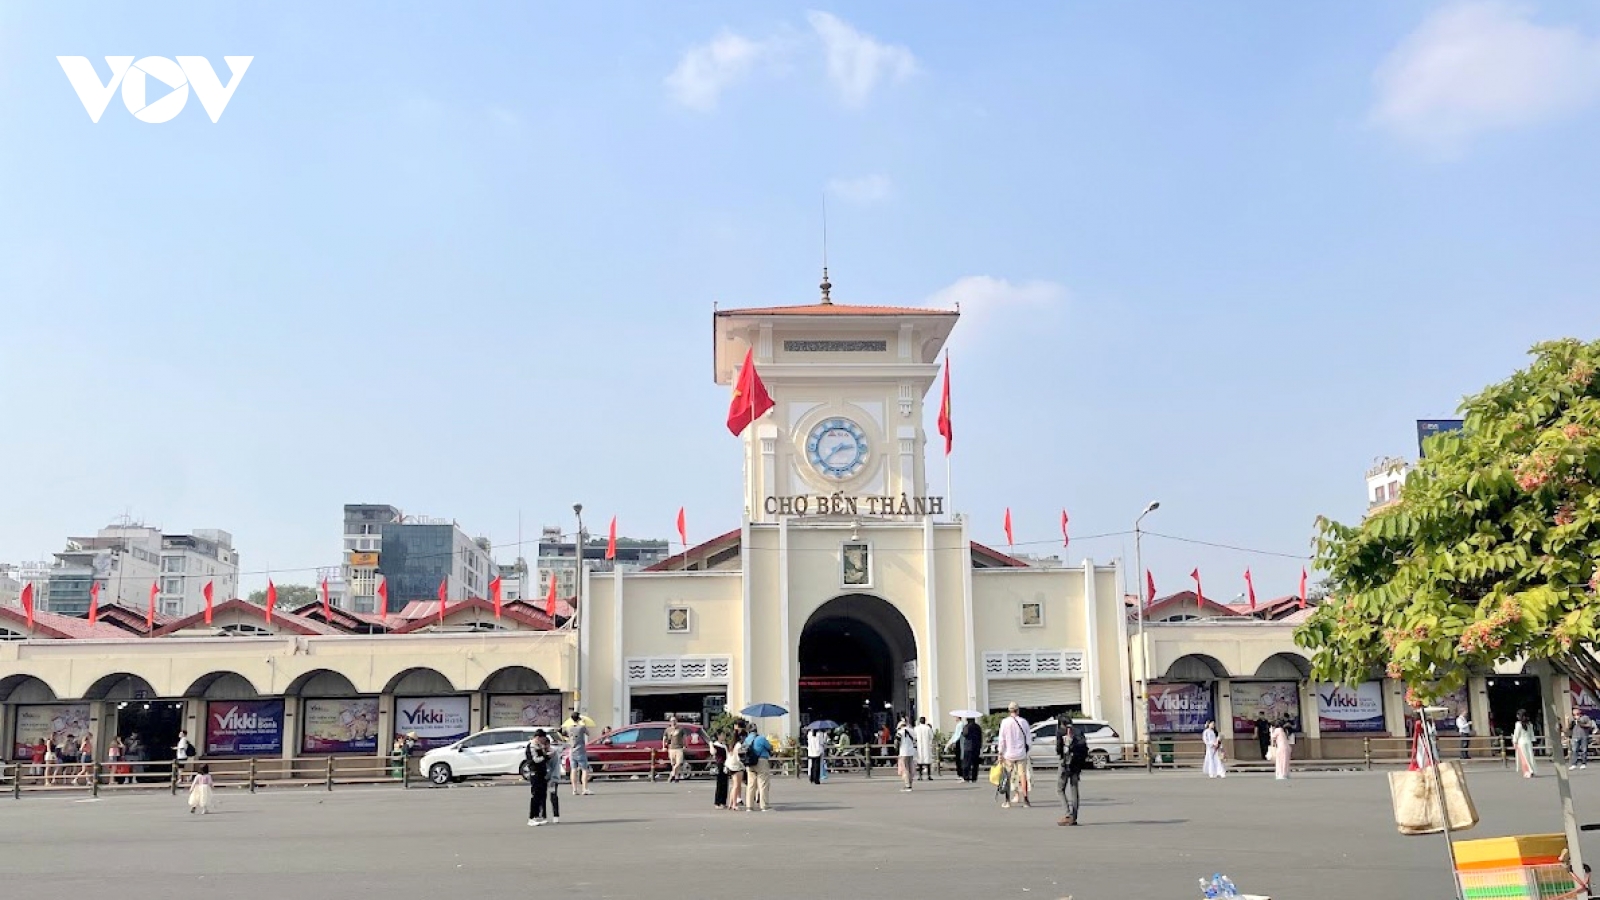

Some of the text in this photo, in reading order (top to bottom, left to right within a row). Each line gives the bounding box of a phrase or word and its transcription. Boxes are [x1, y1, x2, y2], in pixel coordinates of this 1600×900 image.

[764, 490, 944, 517] CHỢ BẾN THÀNH
[1320, 687, 1357, 707] Vikki
[213, 705, 257, 729] Vikki
[402, 701, 443, 724] Vikki
